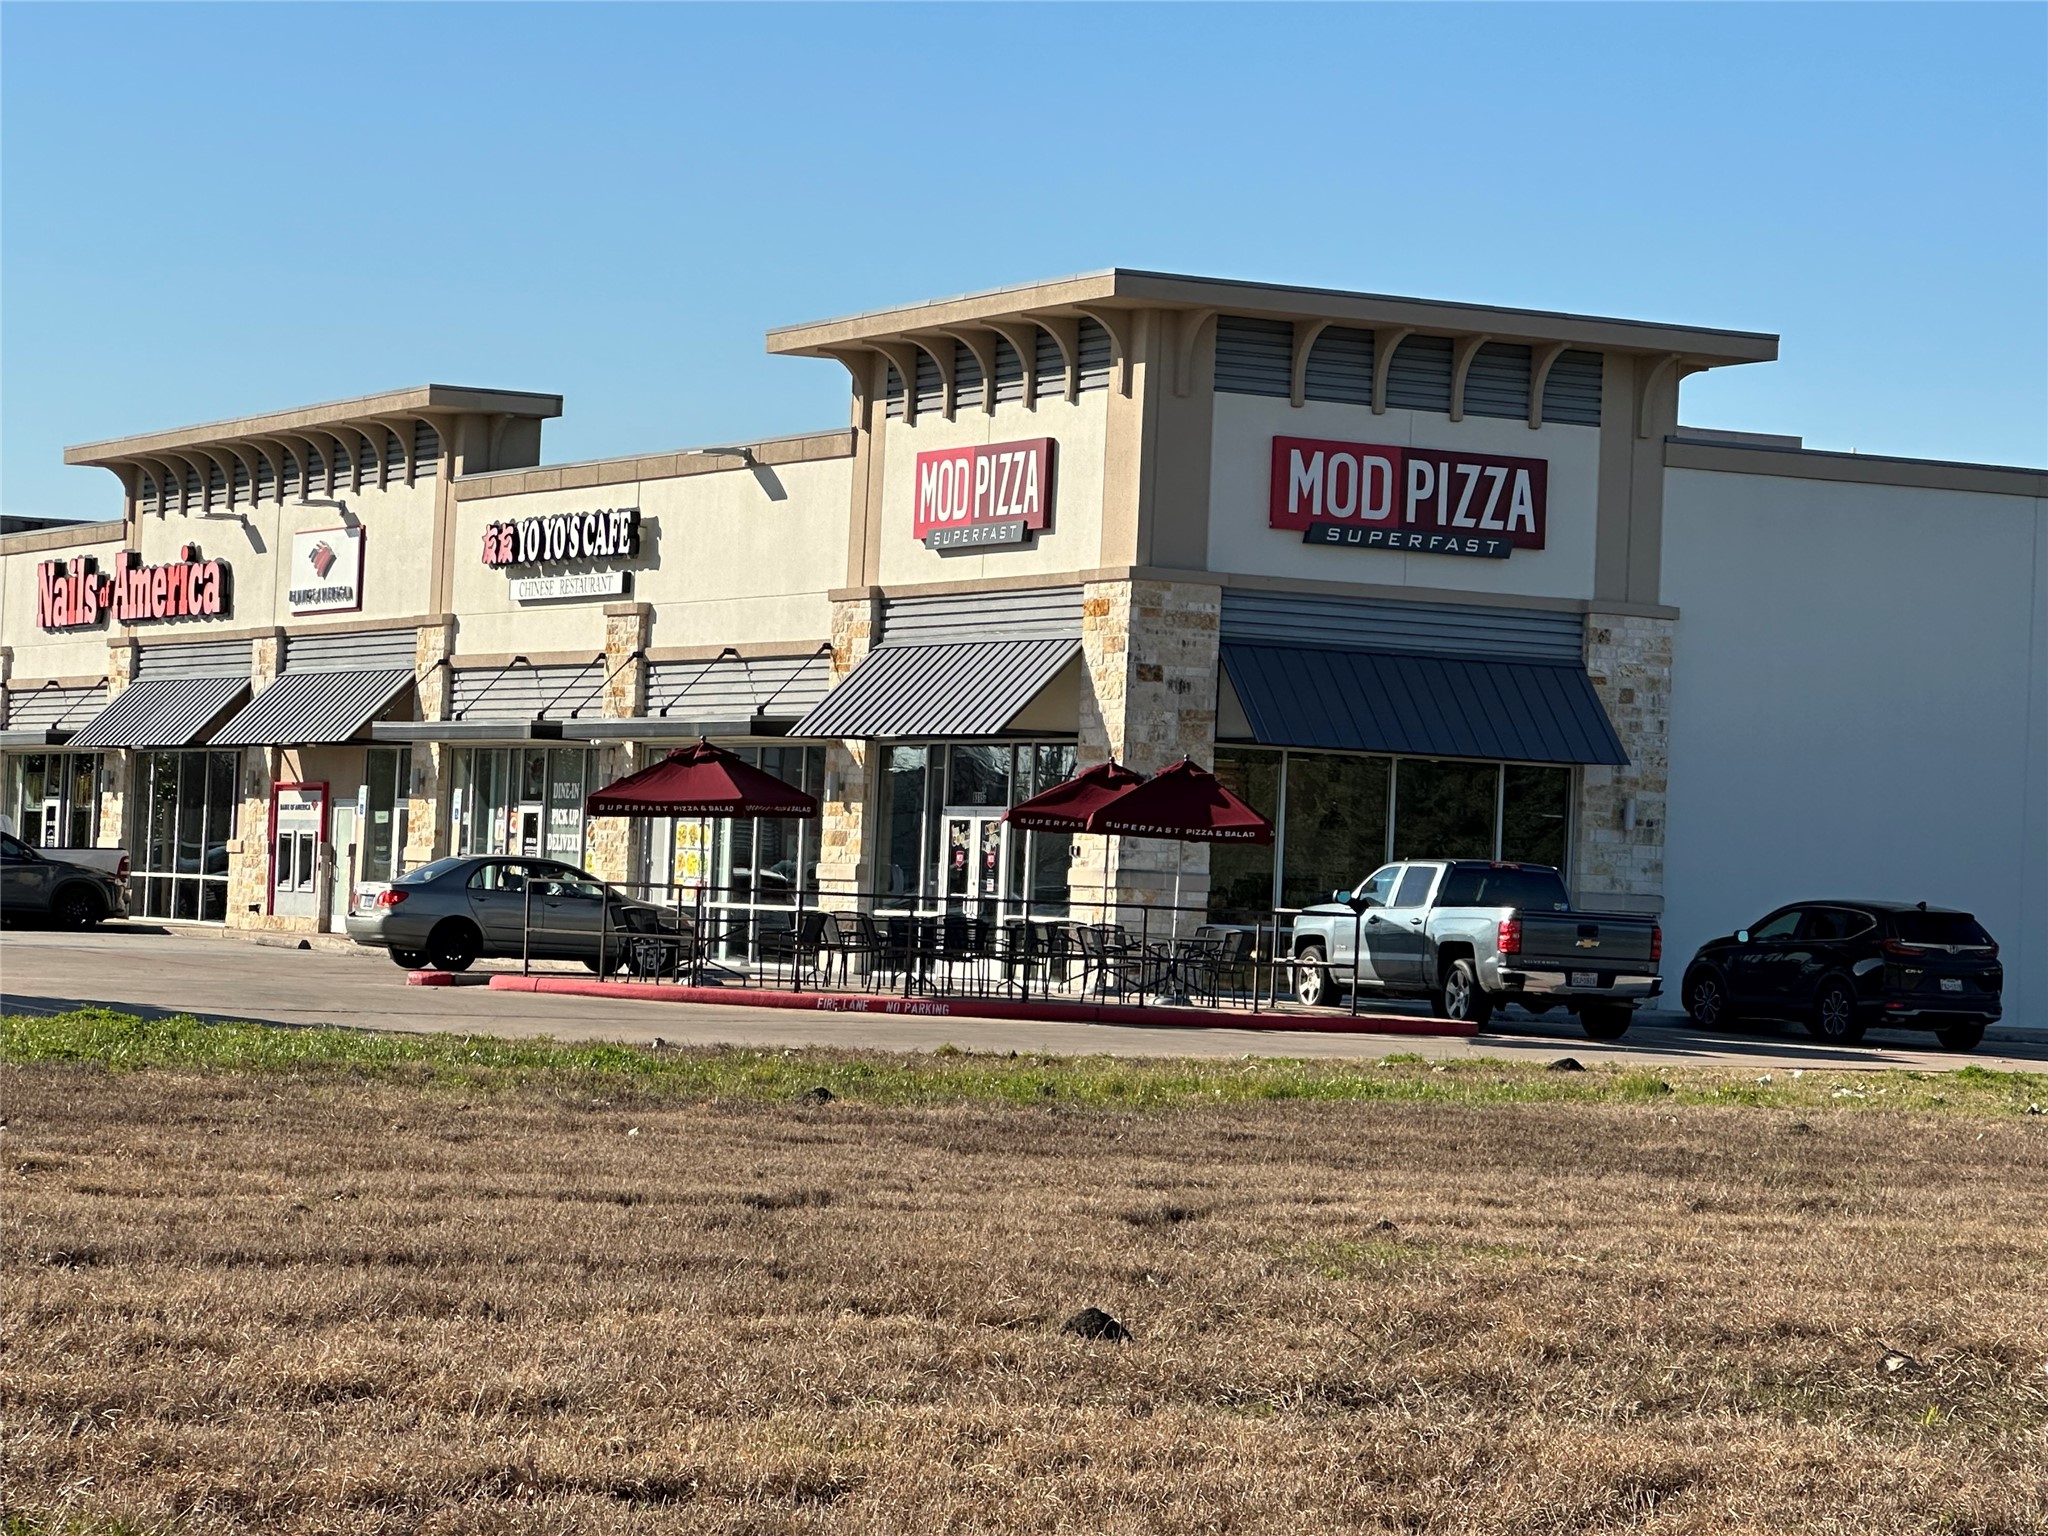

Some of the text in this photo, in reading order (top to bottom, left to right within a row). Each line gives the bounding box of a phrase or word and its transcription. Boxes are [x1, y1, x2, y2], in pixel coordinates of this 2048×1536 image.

[919, 449, 1039, 524] MOD PIZZA
[1288, 448, 1537, 534] MOD PIZZA
[516, 510, 632, 563] YO YO'S CAFE
[933, 525, 1017, 546] SUPERFAST
[1326, 527, 1500, 554] SUPERFAST
[36, 544, 221, 628] Nails of America
[518, 575, 614, 598] CHINESE RESTAURANT
[552, 782, 580, 799] DINE-IN
[551, 808, 580, 825] PICK UP
[598, 804, 669, 812] SUPERFAST
[700, 804, 707, 812] &
[708, 805, 735, 813] SALAD
[1020, 817, 1084, 828] SUPERFAS
[1105, 820, 1256, 838] SUPERFAST PIZZA & SALAD
[547, 833, 582, 851] DELIVER
[816, 997, 950, 1016] FIRE LANE NO PARKING
